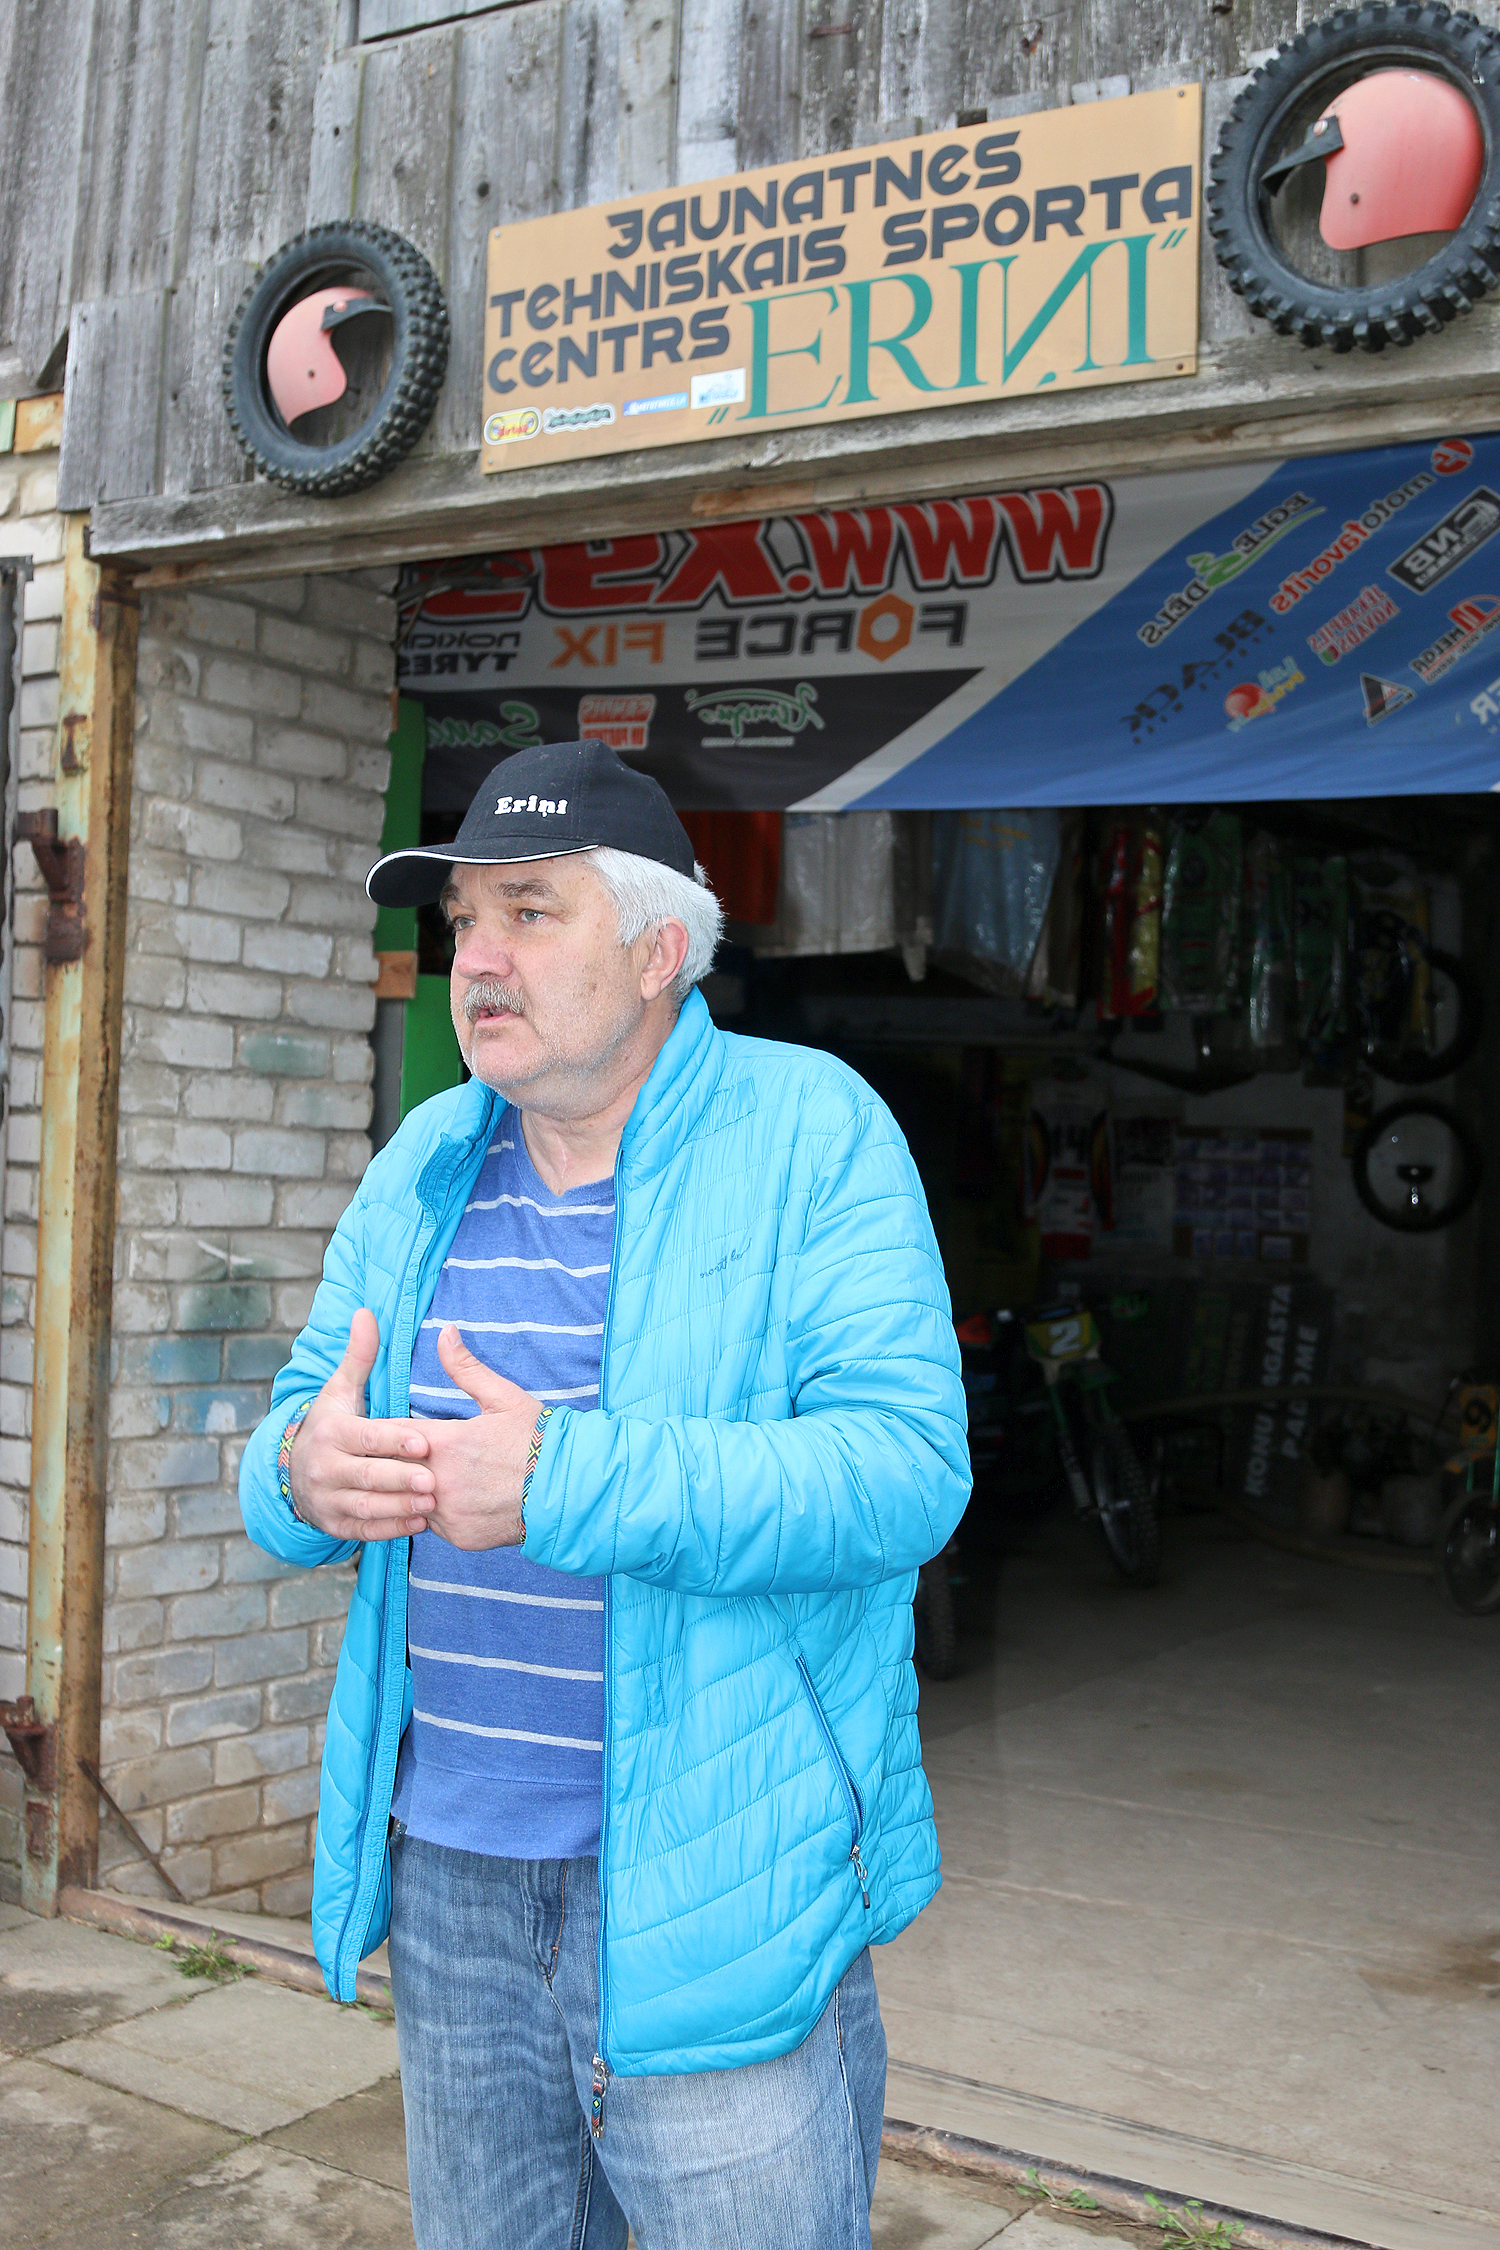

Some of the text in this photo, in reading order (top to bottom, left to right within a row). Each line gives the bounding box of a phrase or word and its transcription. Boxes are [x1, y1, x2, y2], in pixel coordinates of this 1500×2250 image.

[606, 130, 1021, 259] JAUNATNES
[489, 165, 1193, 337] TEHNISKAIS SPORTA
[487, 305, 730, 393] CENTRS
[494, 794, 568, 818] Eriņi
